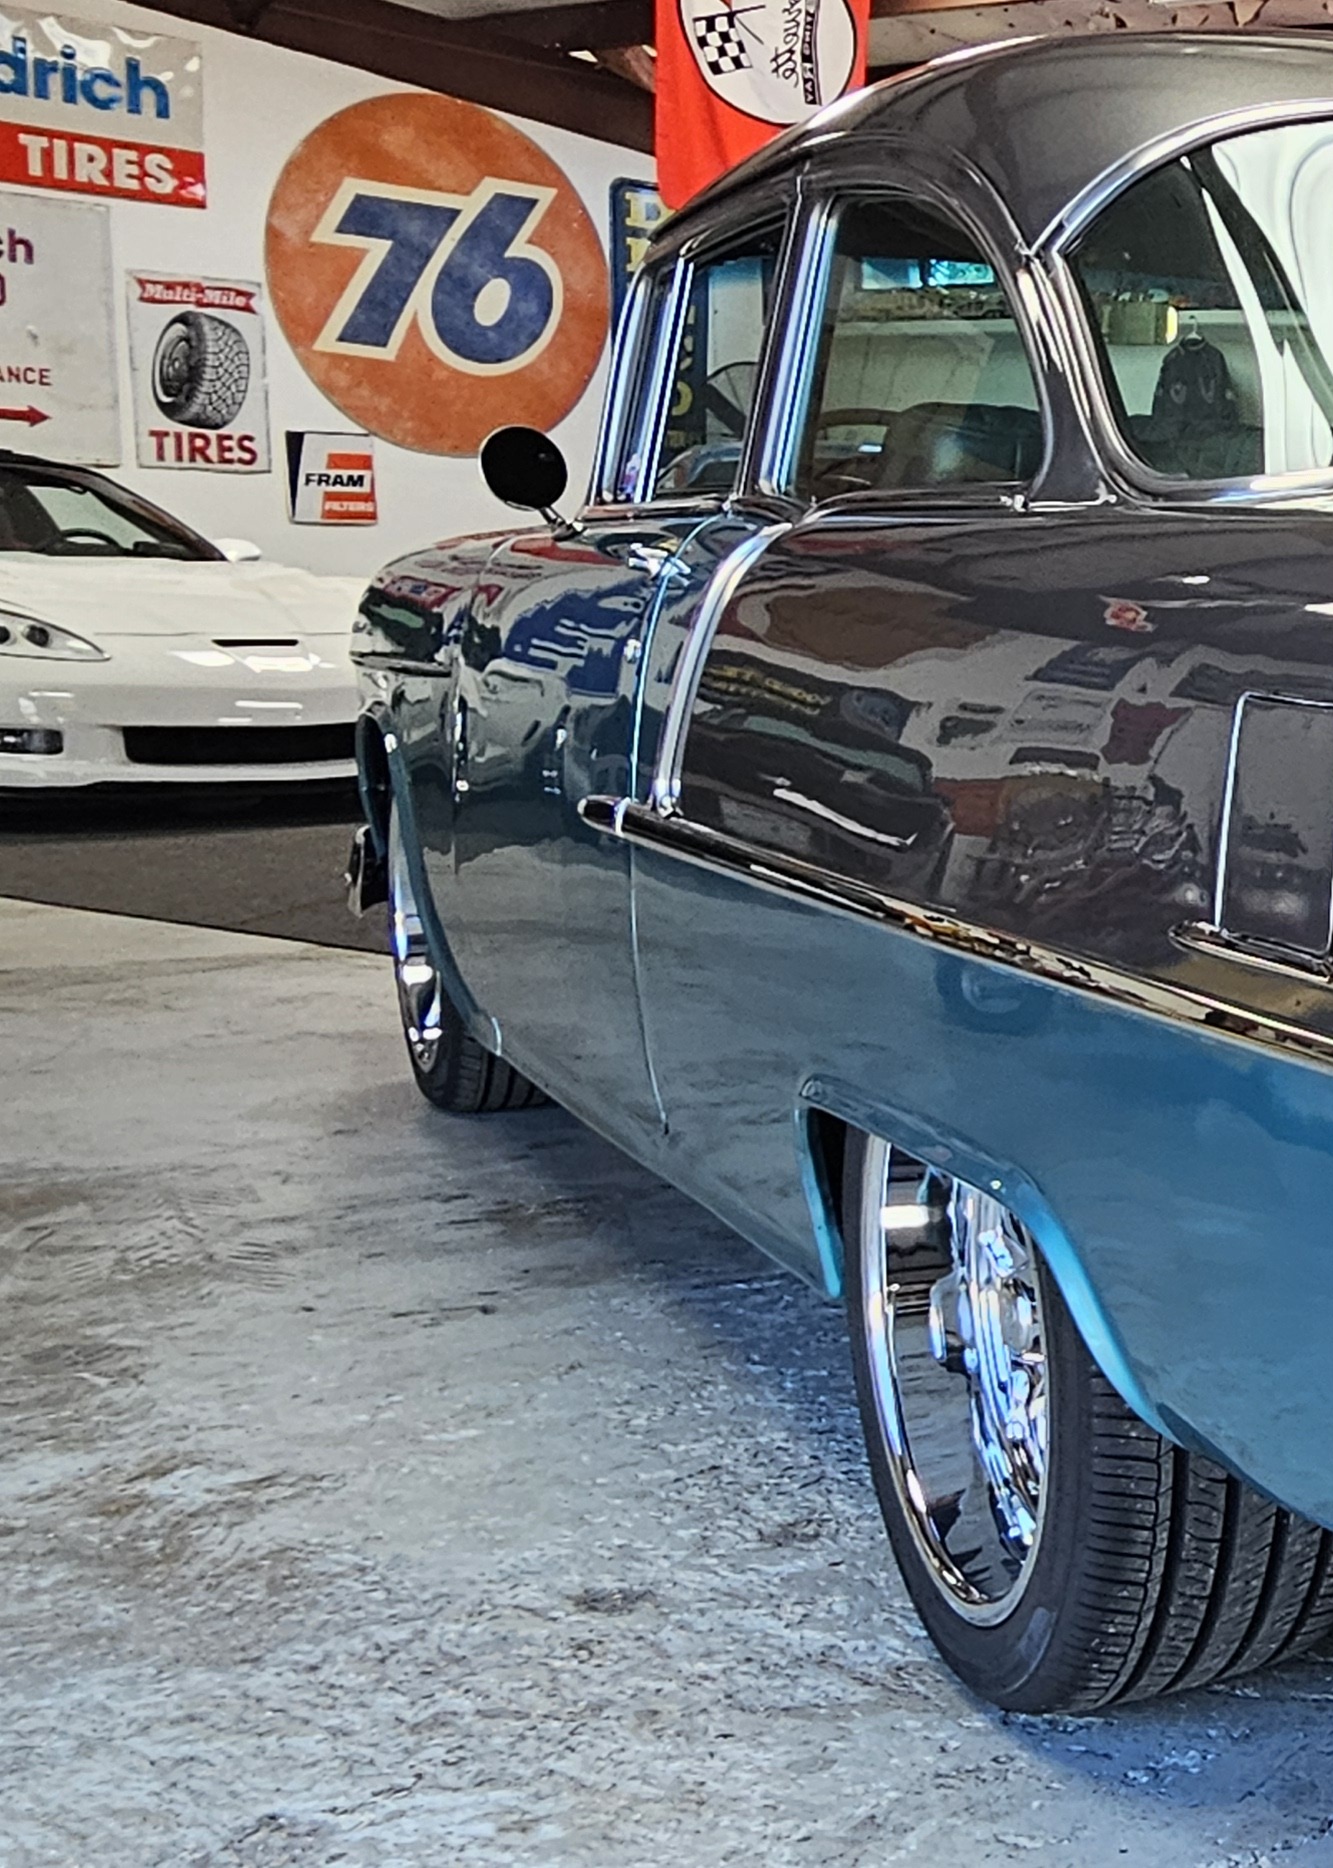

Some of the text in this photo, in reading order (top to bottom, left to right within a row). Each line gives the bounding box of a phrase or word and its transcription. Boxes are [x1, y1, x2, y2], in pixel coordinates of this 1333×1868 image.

[0, 35, 170, 119] drich
[18, 132, 178, 195] TIRES
[0, 228, 35, 265] h
[311, 177, 562, 375] 76
[148, 429, 259, 467] TIRES
[304, 473, 365, 488] FRAM
